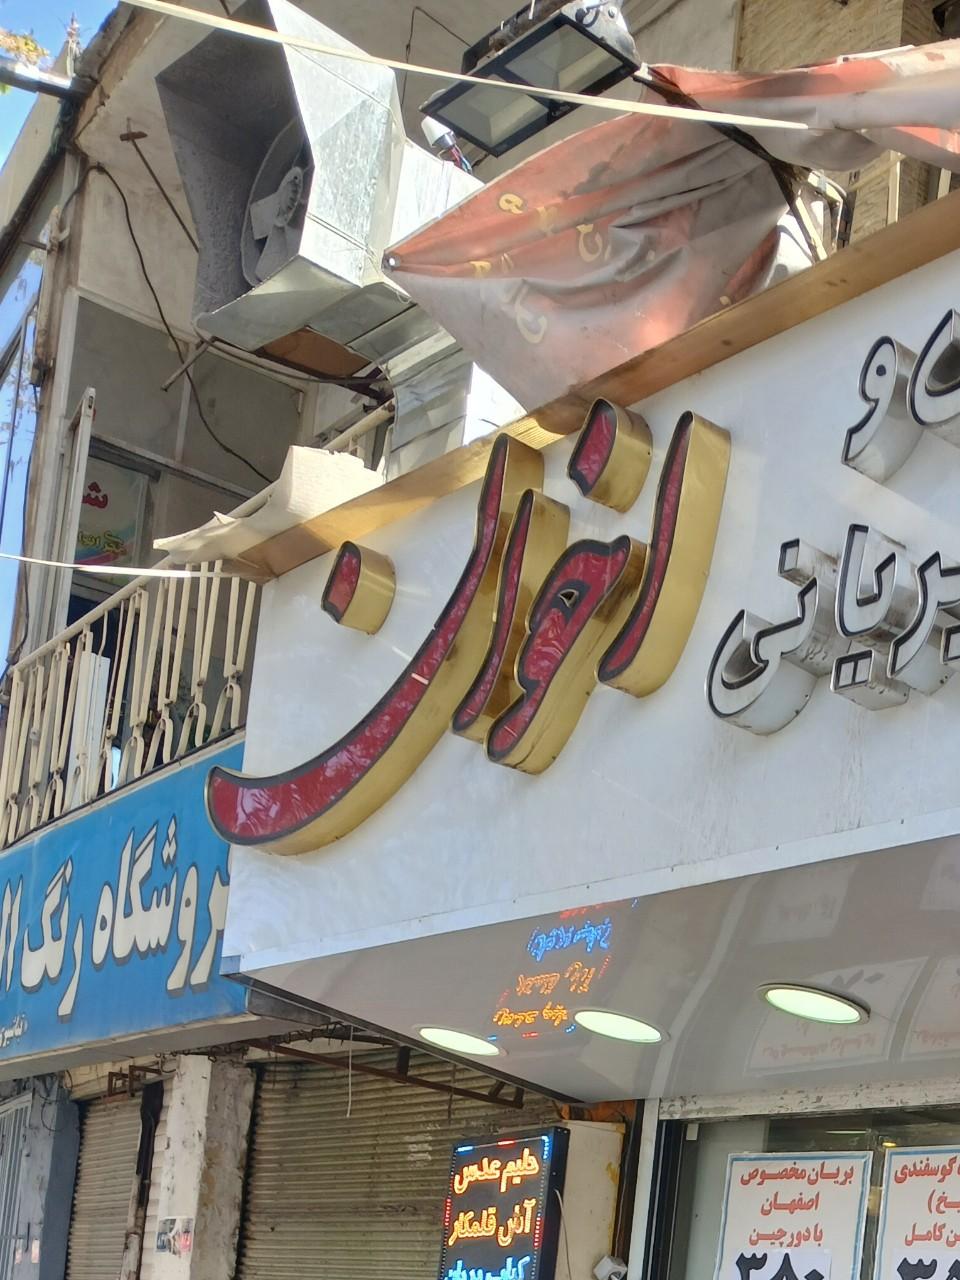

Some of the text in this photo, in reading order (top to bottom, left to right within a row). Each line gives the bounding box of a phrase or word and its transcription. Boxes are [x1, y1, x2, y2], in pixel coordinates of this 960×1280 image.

[841, 335, 910, 474] و
[91, 813, 232, 996] روشگاه
[20, 855, 85, 1023] رنگ
[453, 1147, 540, 1194] حلیم عدس
[740, 1161, 854, 1186] بریان مخصوص
[448, 1198, 537, 1247] آش قلمکار
[760, 1191, 820, 1216] اصفهان
[813, 1223, 824, 1247] با
[904, 1222, 946, 1247] کامل
